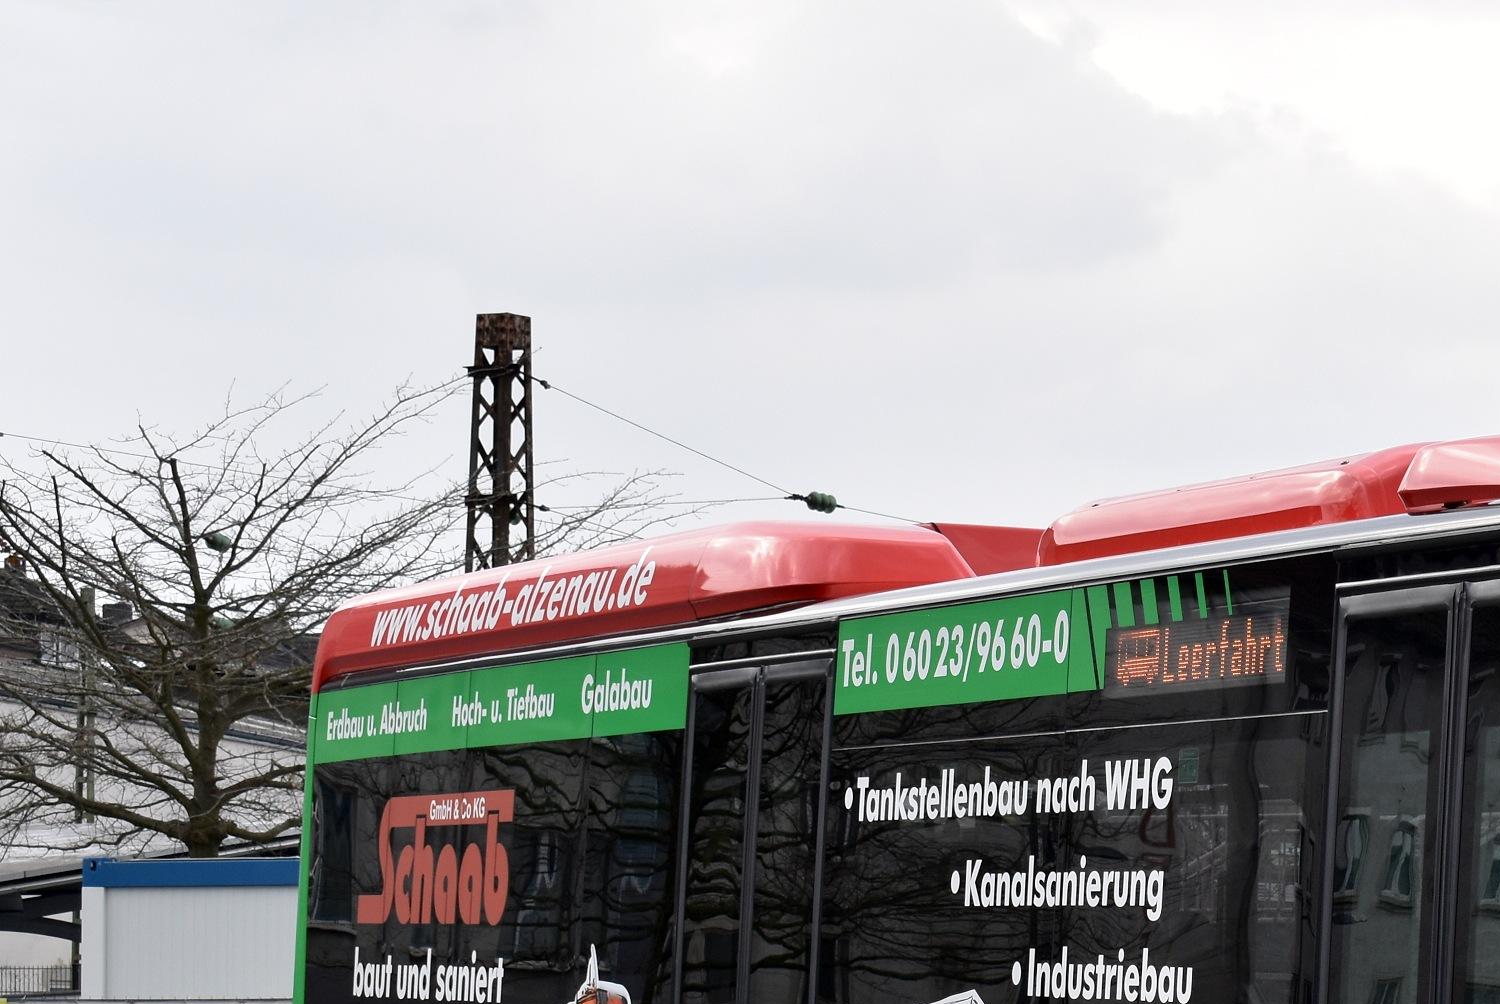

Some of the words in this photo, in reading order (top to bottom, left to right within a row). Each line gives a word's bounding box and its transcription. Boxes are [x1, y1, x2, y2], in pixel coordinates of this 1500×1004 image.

[370, 546, 656, 648] www.schaab-alzenau.de
[842, 633, 878, 688] Tel.
[1163, 616, 1285, 684] Leerfahrt
[326, 707, 365, 741] Erdbau
[366, 714, 377, 737] u.
[378, 698, 428, 735] Abbruch
[451, 691, 488, 727] Hoch-
[490, 699, 503, 724] u.
[506, 684, 555, 722] Tiefbau
[581, 668, 653, 715] Galabau
[429, 799, 453, 821] GmbH
[453, 798, 460, 820] &
[460, 797, 473, 820] Co
[472, 796, 486, 819] KG
[856, 766, 1029, 823] Tankstellenbau
[1035, 759, 1096, 814] nach
[1104, 756, 1174, 811] WHG
[357, 790, 514, 926] Schaab
[964, 854, 1165, 922] Kanalsanierung
[352, 946, 393, 999] baut
[396, 947, 433, 1002] und
[434, 949, 505, 1004] saniert
[1027, 945, 1193, 1004] Industriebau
